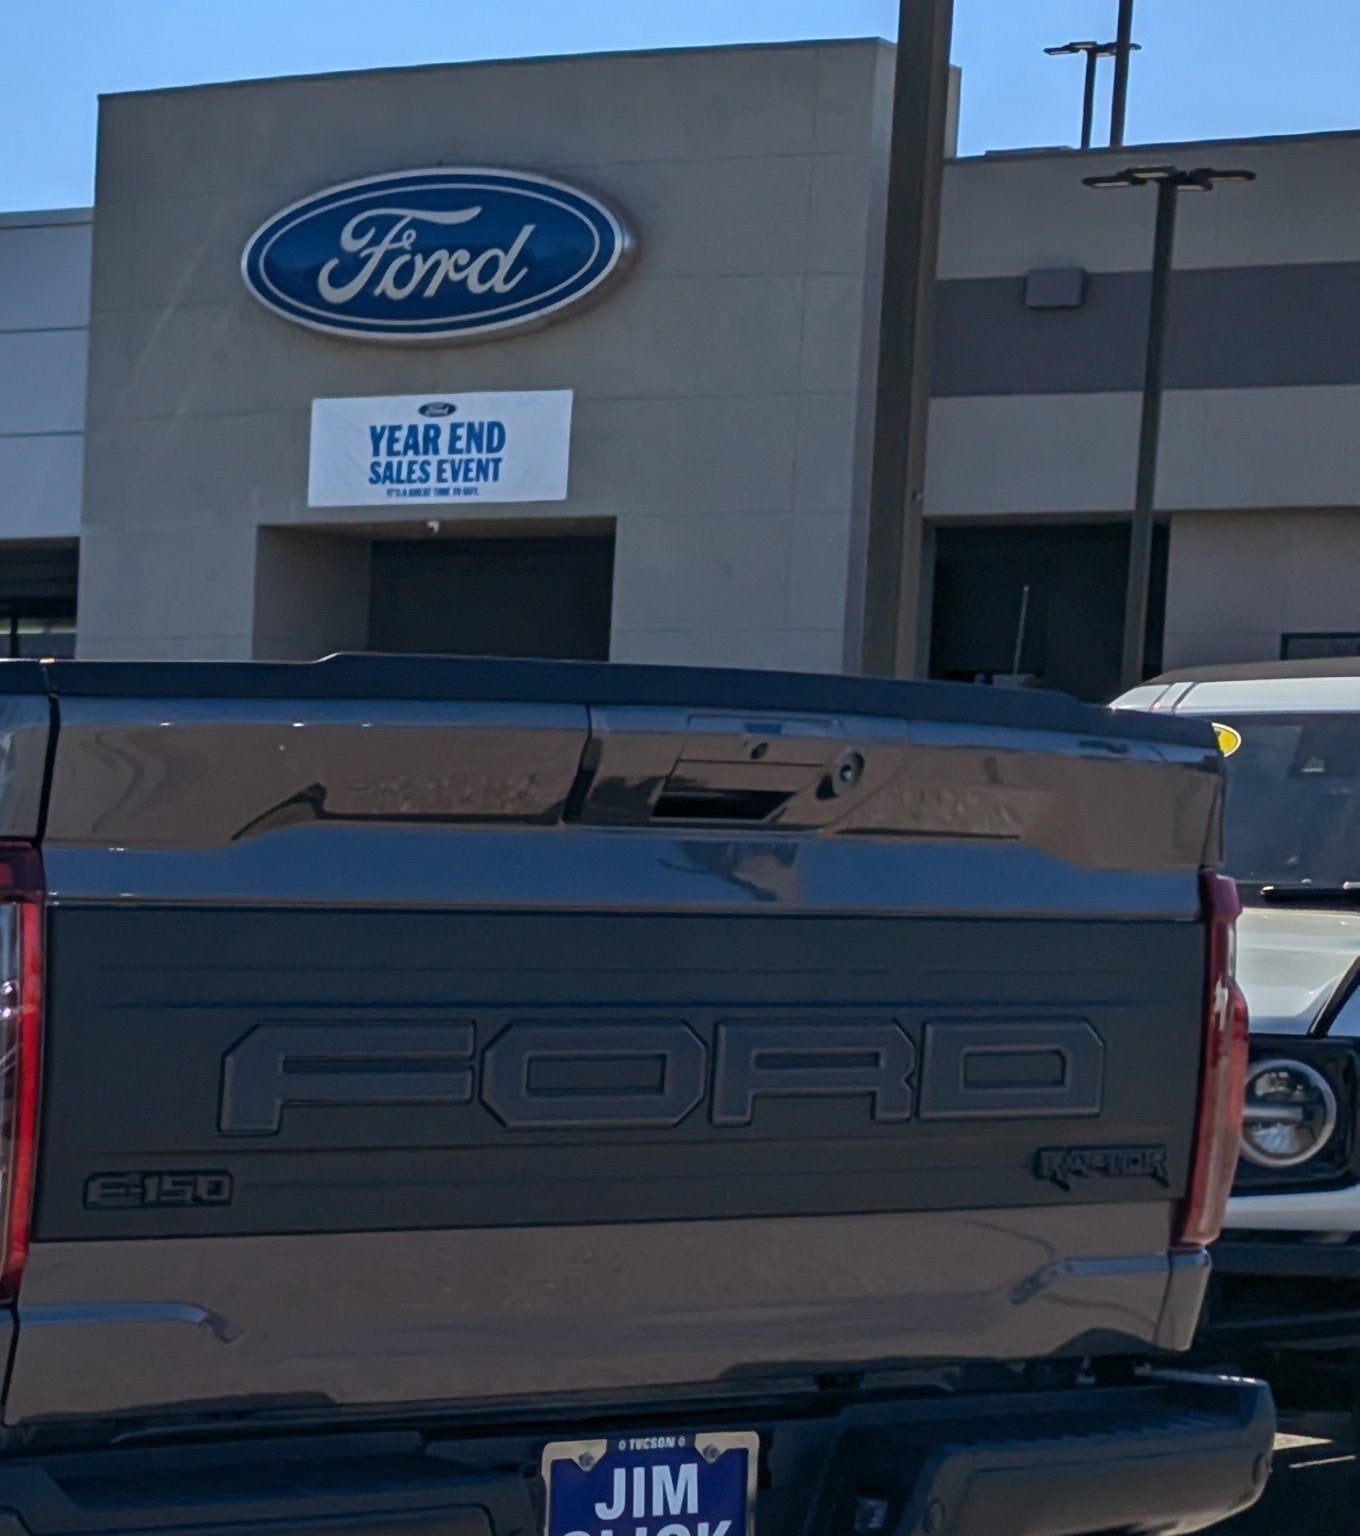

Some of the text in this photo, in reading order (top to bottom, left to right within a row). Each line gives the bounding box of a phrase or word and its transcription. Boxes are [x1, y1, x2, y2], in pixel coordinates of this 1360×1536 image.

[318, 206, 536, 304] Ford
[369, 420, 506, 457] YEAR END
[368, 457, 503, 484] SALES EVENT
[217, 1016, 1105, 1136] FORD
[1033, 1142, 1169, 1190] RAPTOR
[83, 1170, 234, 1210] F-150
[628, 1437, 676, 1450] TUCSON
[594, 1462, 699, 1521] JIM
